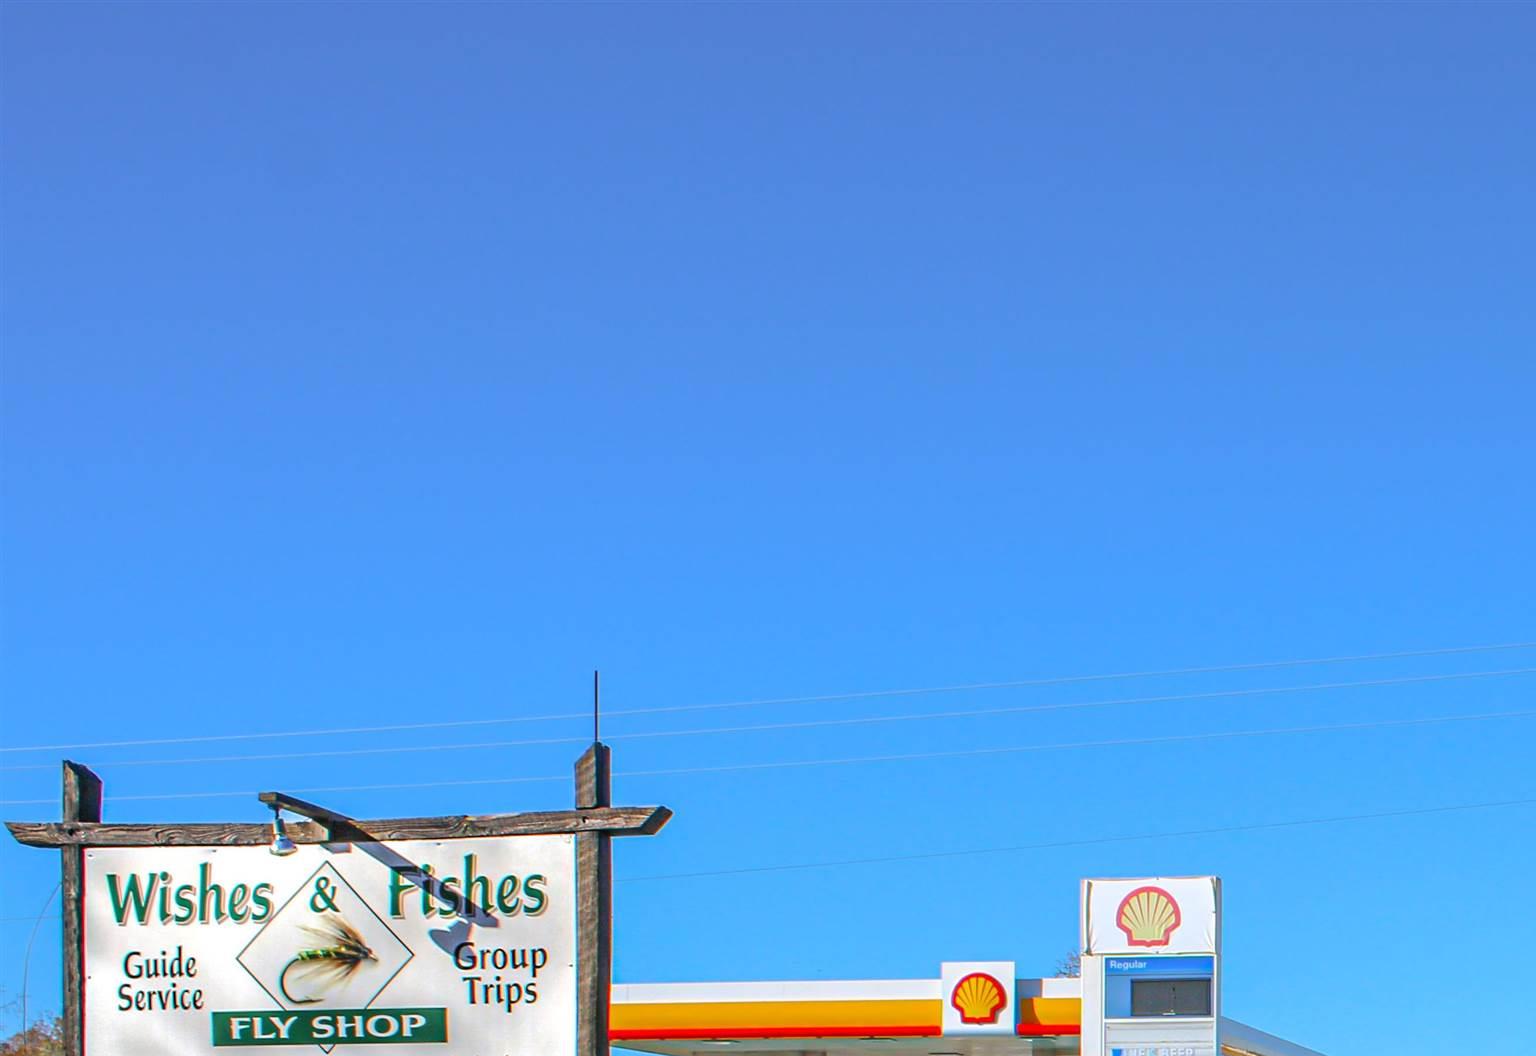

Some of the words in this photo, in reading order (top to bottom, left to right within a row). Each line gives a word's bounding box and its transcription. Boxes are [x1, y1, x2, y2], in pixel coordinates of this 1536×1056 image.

[106, 862, 275, 926] Wishes
[310, 876, 340, 912] &
[388, 853, 549, 919] Fishes
[123, 945, 198, 979] Guide
[453, 941, 549, 978] Group
[1109, 960, 1147, 970] Regular
[117, 983, 205, 1011] Service
[462, 976, 538, 1013] Trips
[230, 1016, 298, 1040] FLY
[311, 1014, 427, 1039] SHOP
